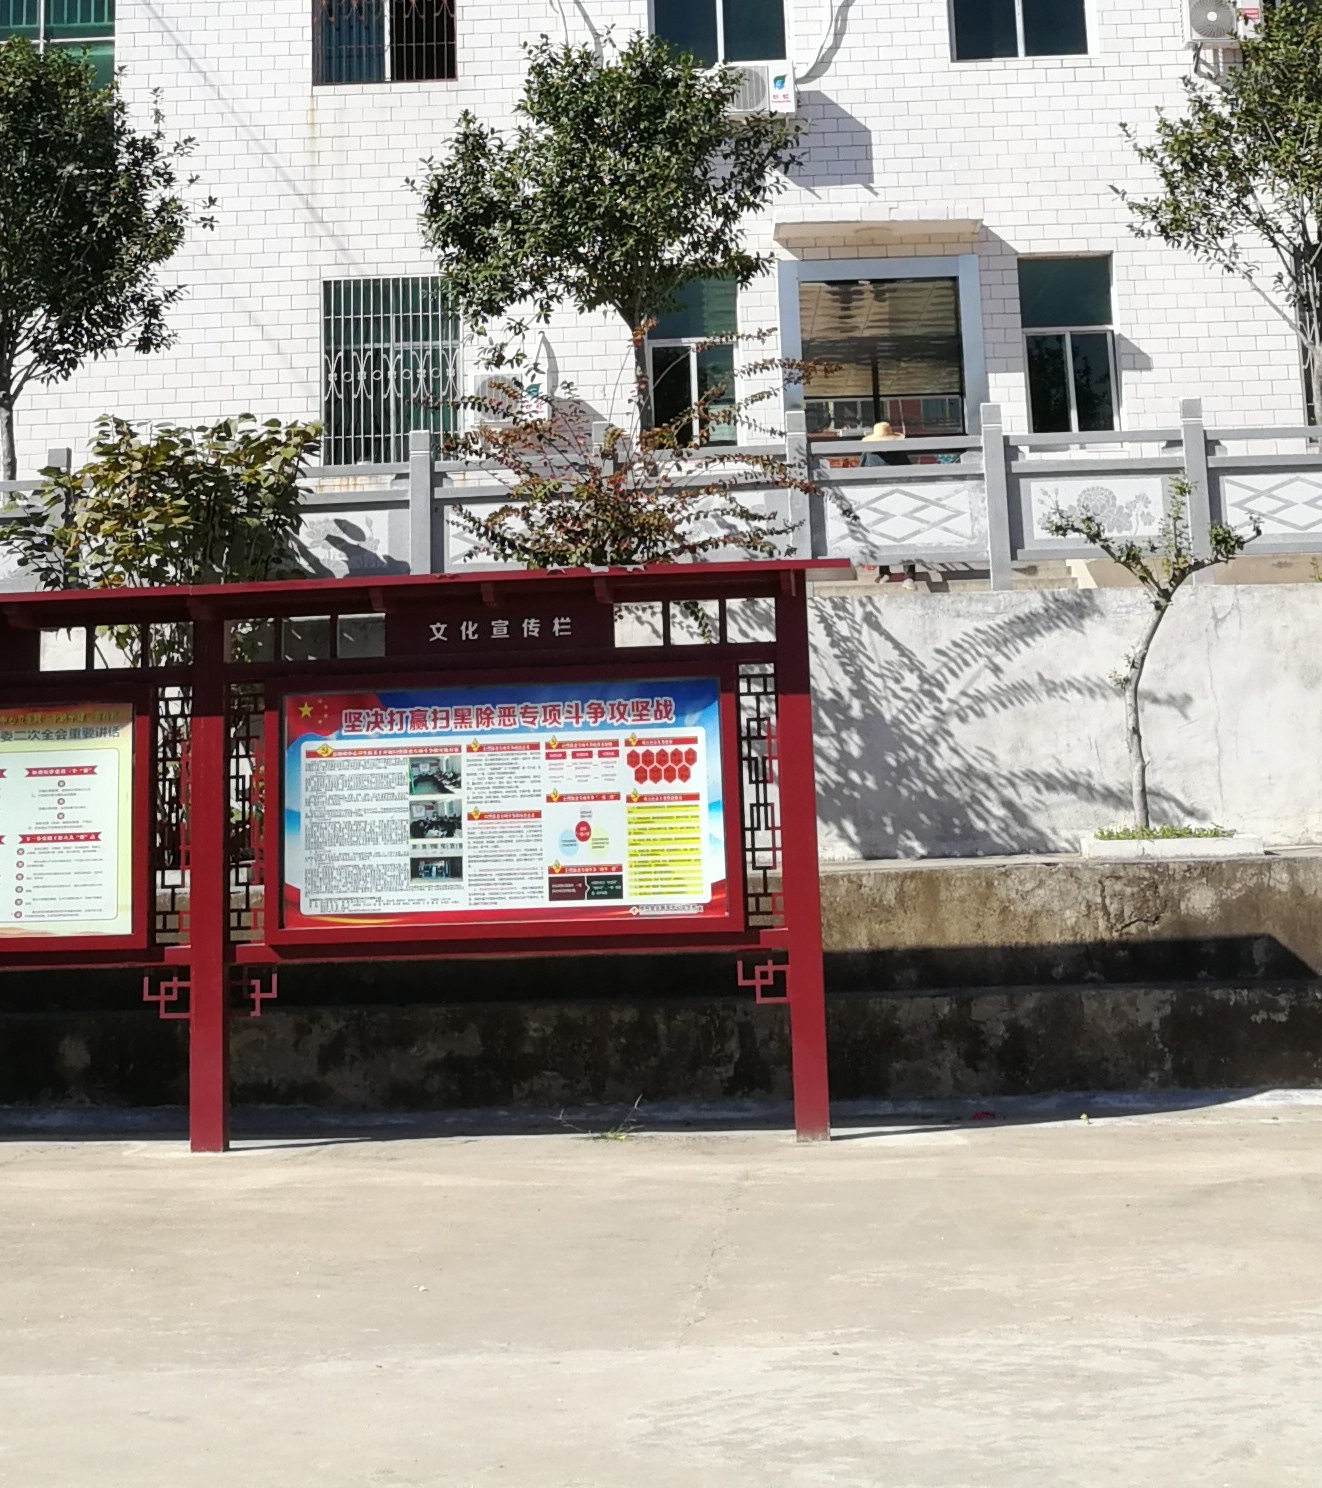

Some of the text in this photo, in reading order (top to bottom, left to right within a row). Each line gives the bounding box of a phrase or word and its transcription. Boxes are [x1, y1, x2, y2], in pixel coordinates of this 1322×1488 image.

[429, 616, 573, 642] 文化宣传栏
[342, 699, 674, 734] 坚决打赢扫黑除恶专项斗争攻坚战
